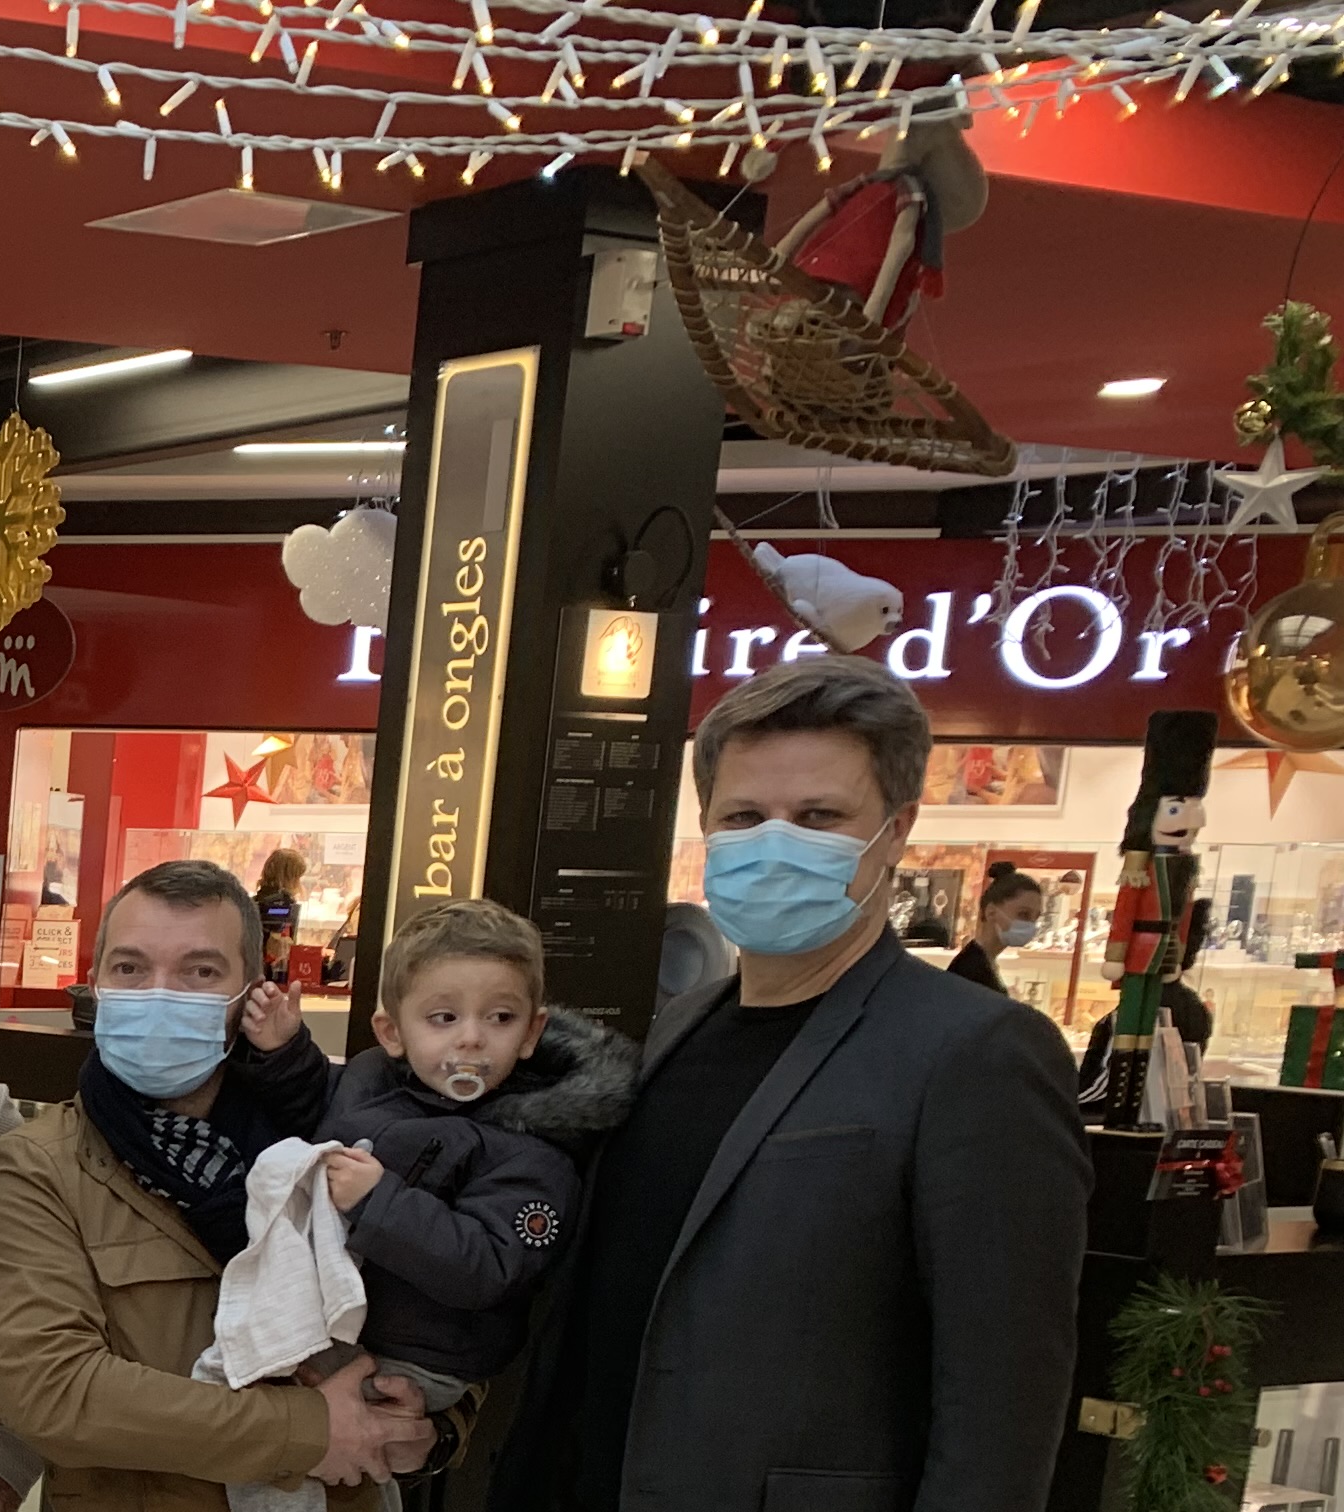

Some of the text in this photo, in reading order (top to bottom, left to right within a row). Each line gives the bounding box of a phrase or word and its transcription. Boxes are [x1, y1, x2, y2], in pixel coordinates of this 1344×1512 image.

[414, 535, 490, 898] bar à ongles
